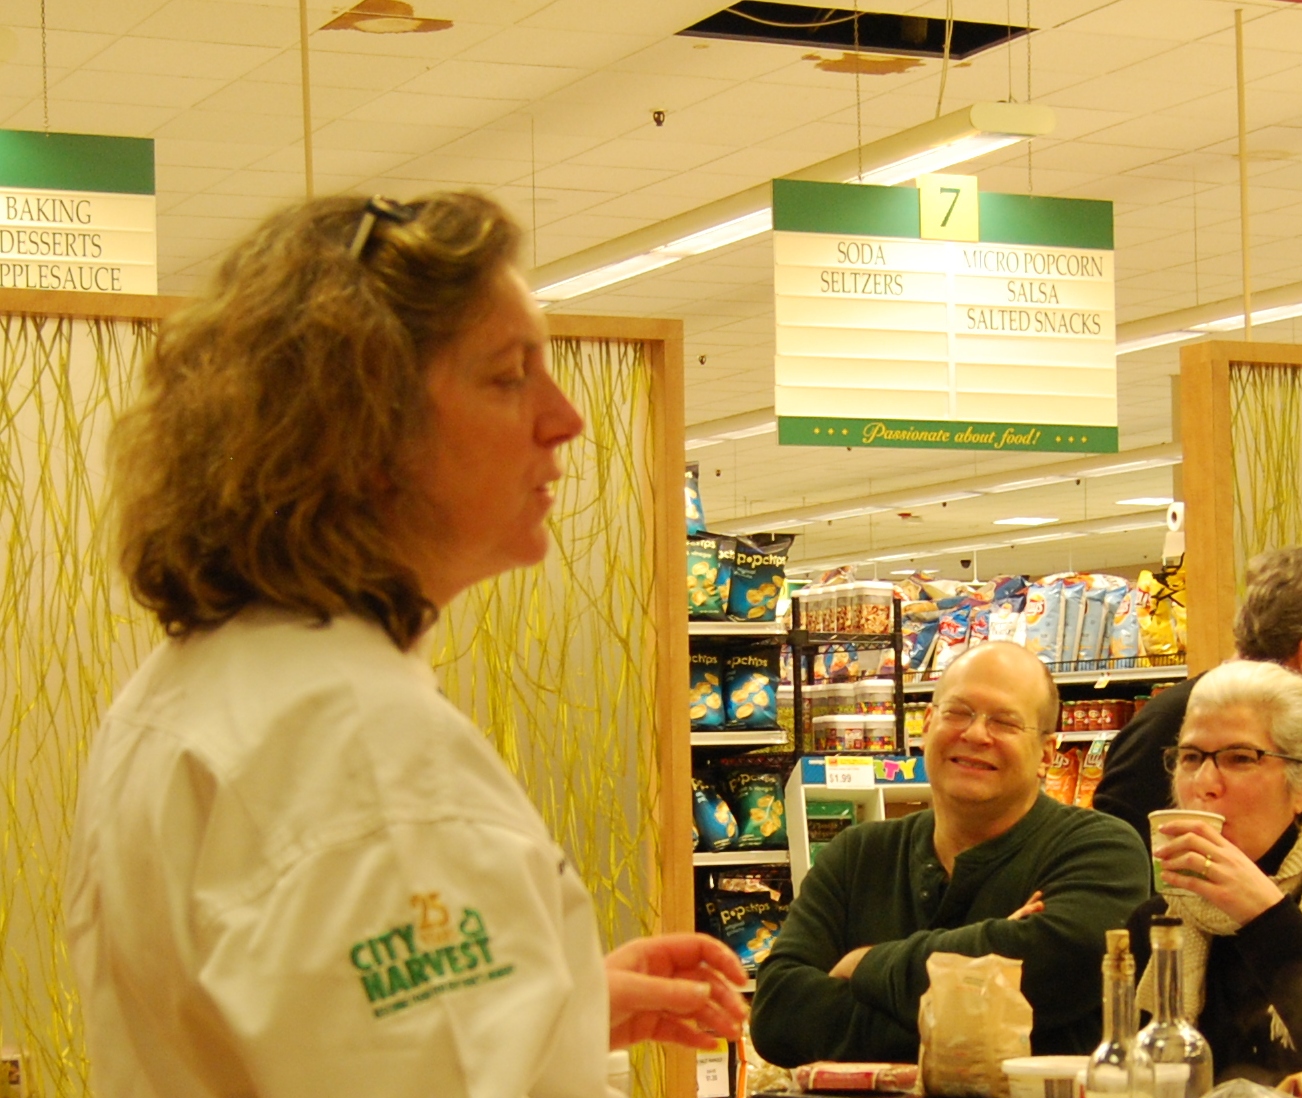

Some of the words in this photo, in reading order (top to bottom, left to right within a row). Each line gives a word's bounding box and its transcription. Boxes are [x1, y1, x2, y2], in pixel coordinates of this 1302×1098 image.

[6, 196, 91, 225] BAKING
[939, 187, 961, 228] 7
[0, 230, 102, 258] DESSERTS
[837, 241, 887, 266] SODA
[963, 249, 1019, 274] MICRO
[1024, 252, 1104, 278] POPCORN
[820, 270, 904, 296] SELTZERS
[1007, 280, 1060, 305] SALSA
[967, 308, 1031, 332] SALTED
[1034, 310, 1101, 335] SNACKS
[862, 422, 950, 444] Passionate
[954, 428, 995, 444] about
[994, 428, 1042, 449] food!
[350, 923, 416, 971] CITY
[361, 935, 493, 1003] HARVEST
